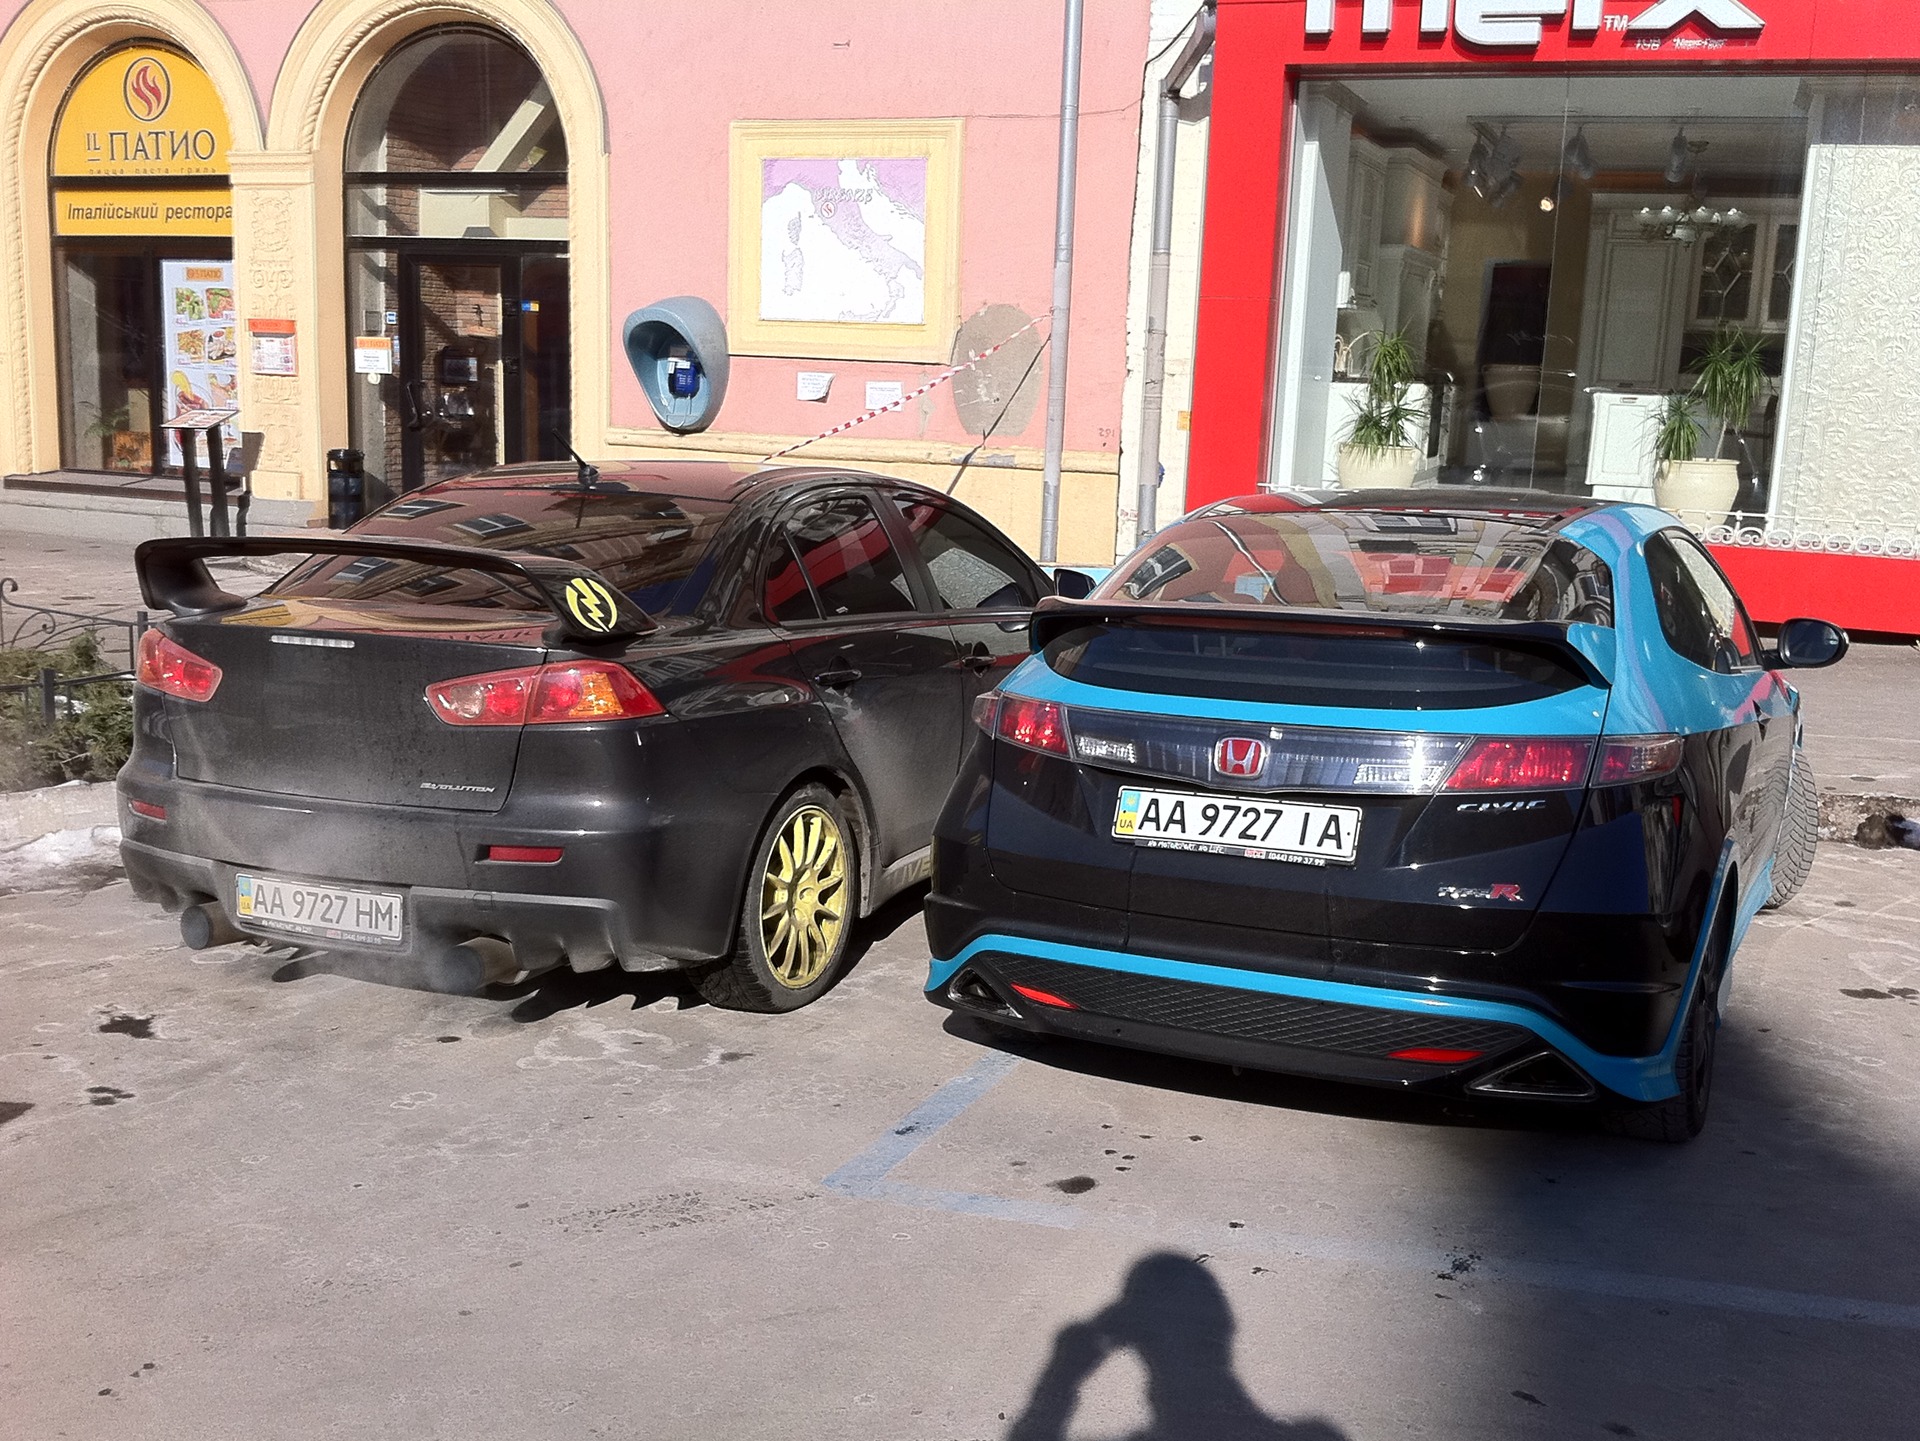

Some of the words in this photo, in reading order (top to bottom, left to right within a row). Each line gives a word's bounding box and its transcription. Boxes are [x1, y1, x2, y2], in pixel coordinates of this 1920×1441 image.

[1603, 15, 1628, 31] TM
[109, 130, 215, 160] ПАТИО
[134, 167, 170, 175] паста
[67, 202, 159, 220] Італійський
[1457, 800, 1546, 814] CIVIC
[1119, 818, 1134, 830] UA
[1138, 798, 1187, 834] AA
[1199, 803, 1283, 842] 9727
[1299, 811, 1342, 850] IA
[253, 884, 286, 917] AA
[292, 890, 349, 925] 9727
[356, 897, 394, 932] HM
